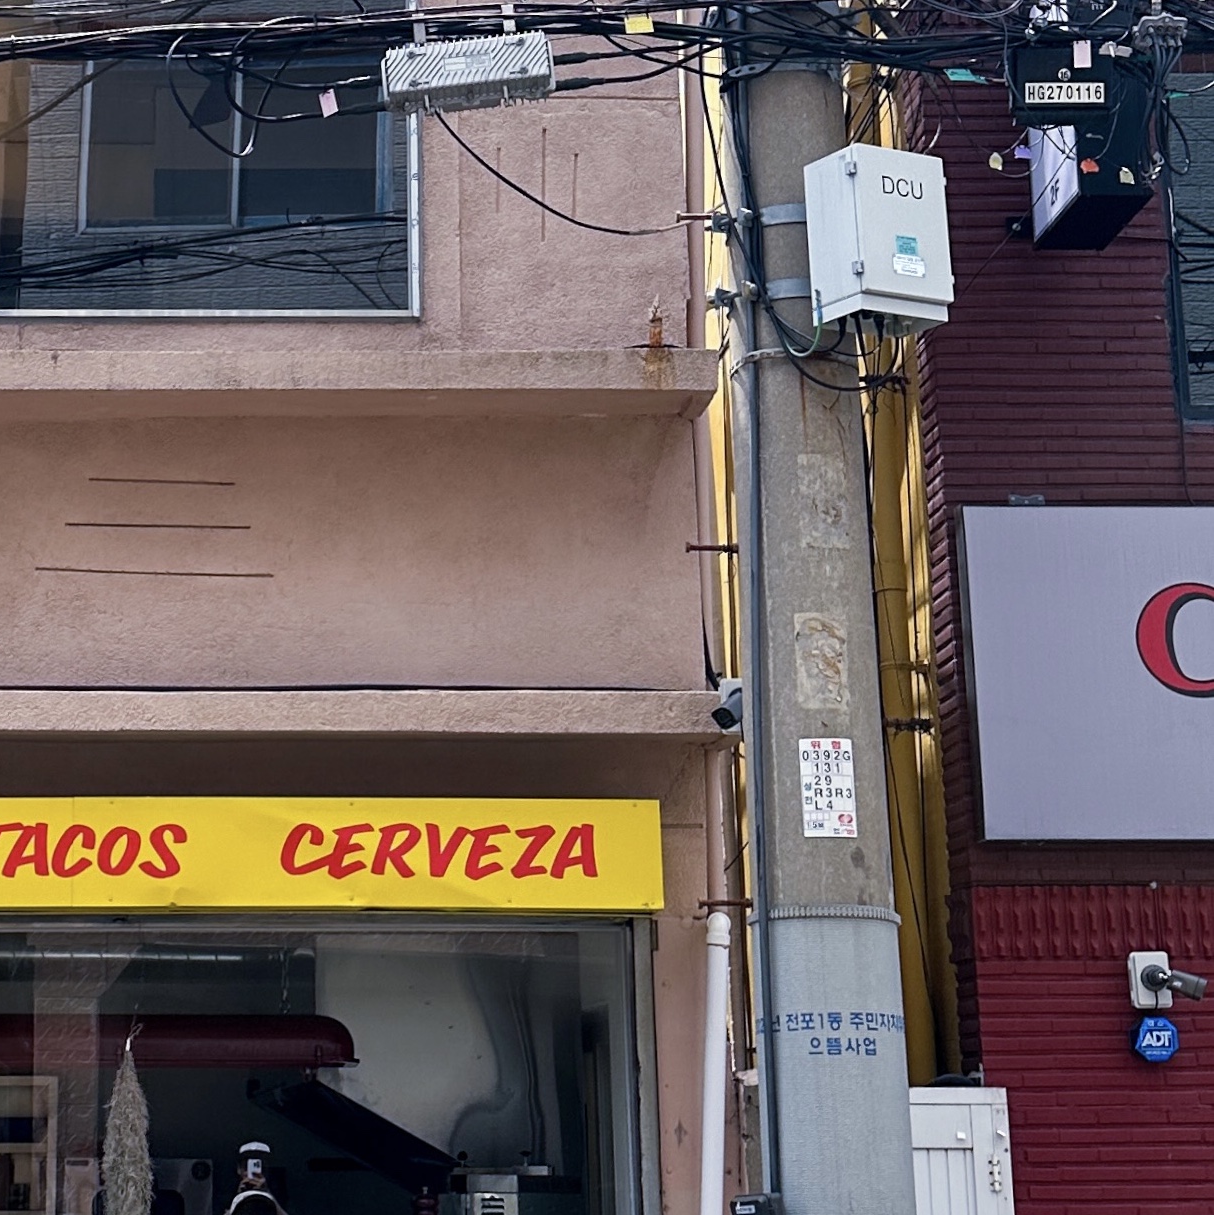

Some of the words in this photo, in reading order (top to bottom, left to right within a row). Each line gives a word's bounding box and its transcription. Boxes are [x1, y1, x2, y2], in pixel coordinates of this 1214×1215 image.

[1028, 85, 1103, 100] HG270116
[882, 175, 923, 199] DCU
[814, 775, 832, 786] 29
[280, 822, 599, 879] CERVEZA
[786, 1012, 842, 1031] 전포1동
[1141, 1031, 1172, 1047] ADT
